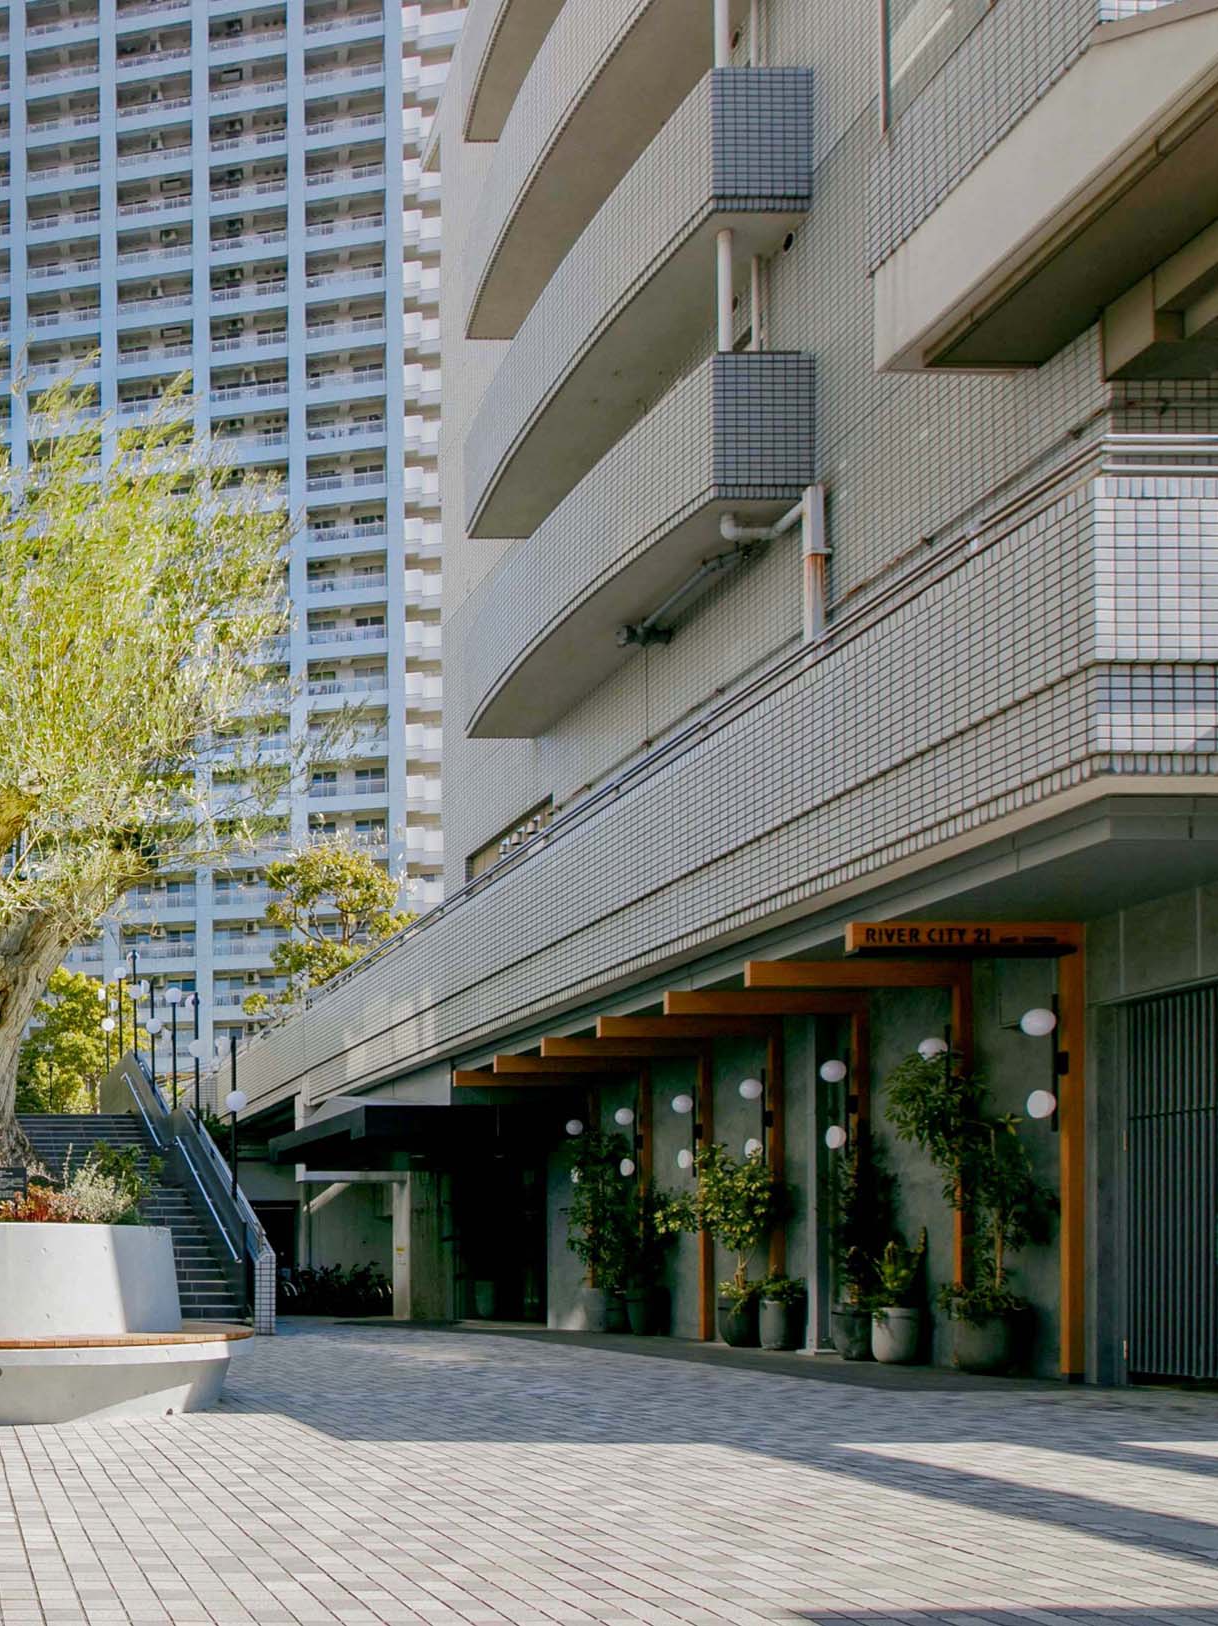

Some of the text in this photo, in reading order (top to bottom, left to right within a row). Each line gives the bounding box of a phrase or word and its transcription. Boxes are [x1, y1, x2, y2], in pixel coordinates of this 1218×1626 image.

[865, 928, 921, 944] RIVER
[928, 928, 967, 944] CITY
[974, 928, 991, 944] 21
